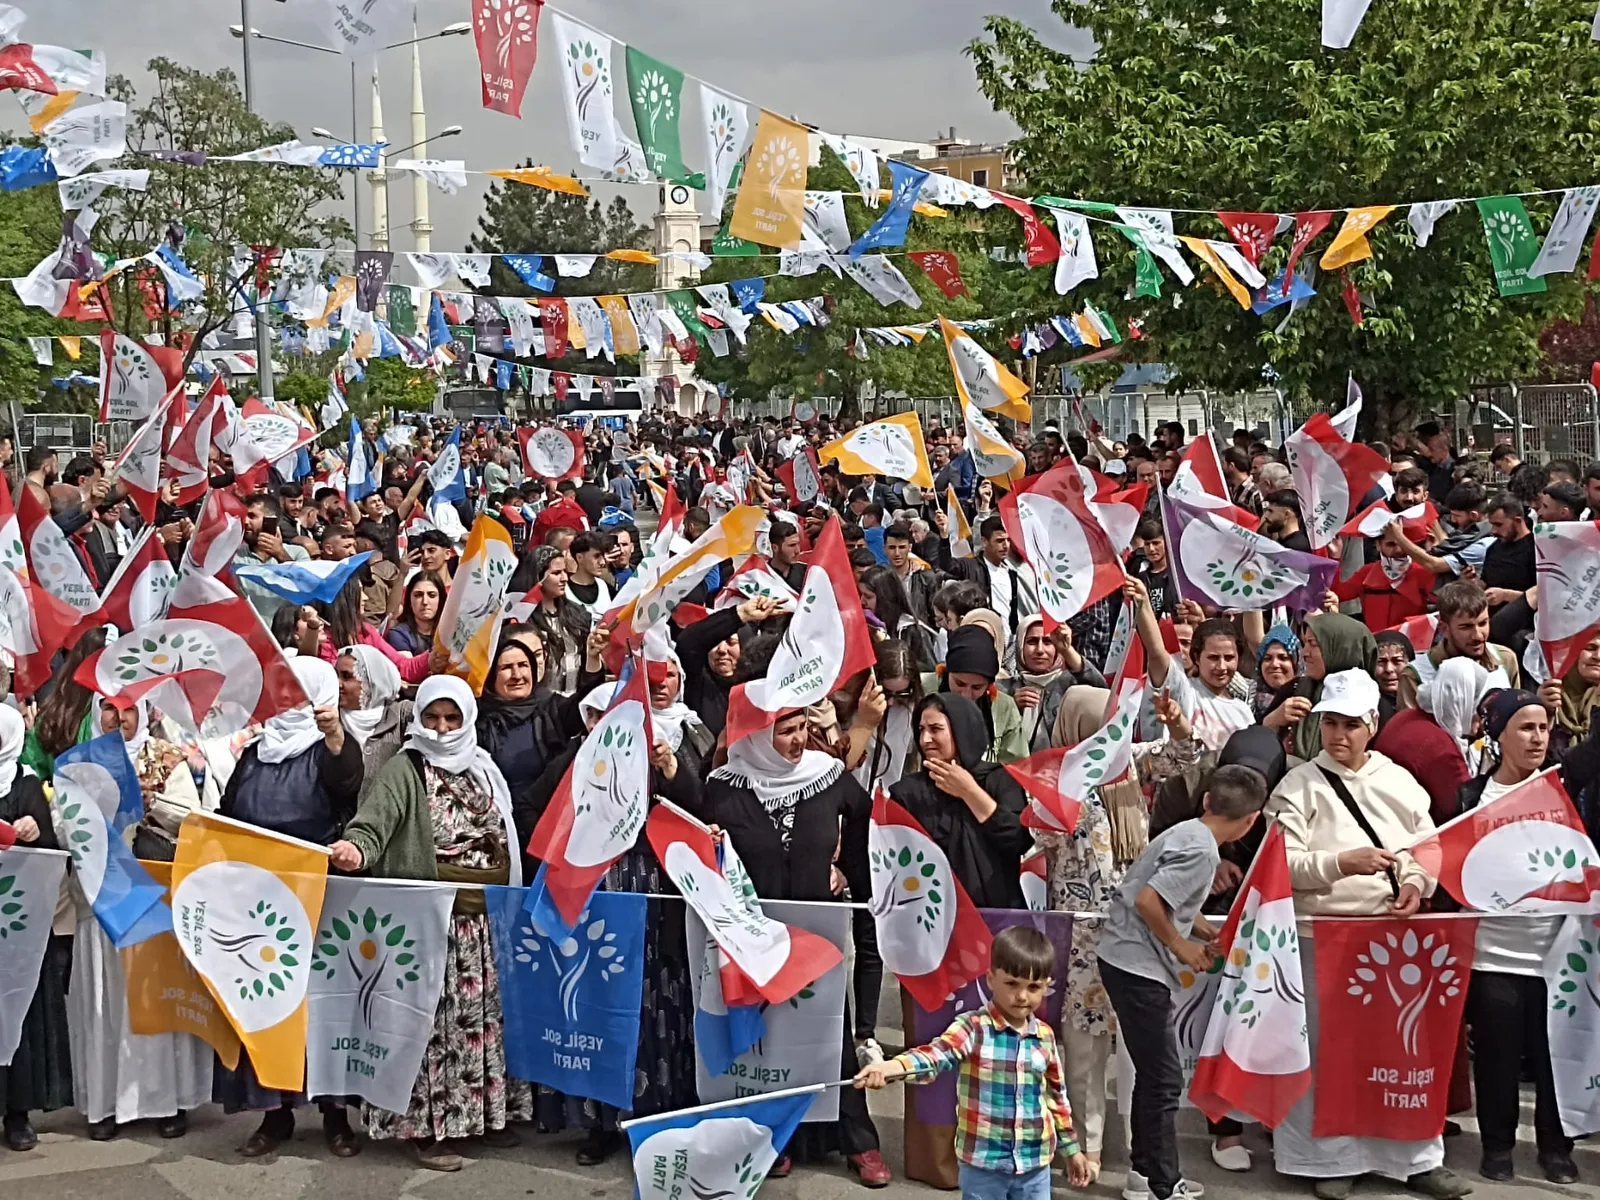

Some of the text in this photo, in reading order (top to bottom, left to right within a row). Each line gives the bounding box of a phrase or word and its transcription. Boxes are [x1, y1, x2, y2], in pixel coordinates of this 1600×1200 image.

[1314, 499, 1331, 517] SOL
[1315, 512, 1338, 537] PARTİ
[1582, 565, 1600, 584] SOL
[1584, 583, 1600, 612] PAR
[193, 935, 203, 956] SOL
[653, 1154, 667, 1192] PARTİ
[673, 1148, 688, 1181] YEŞİL
